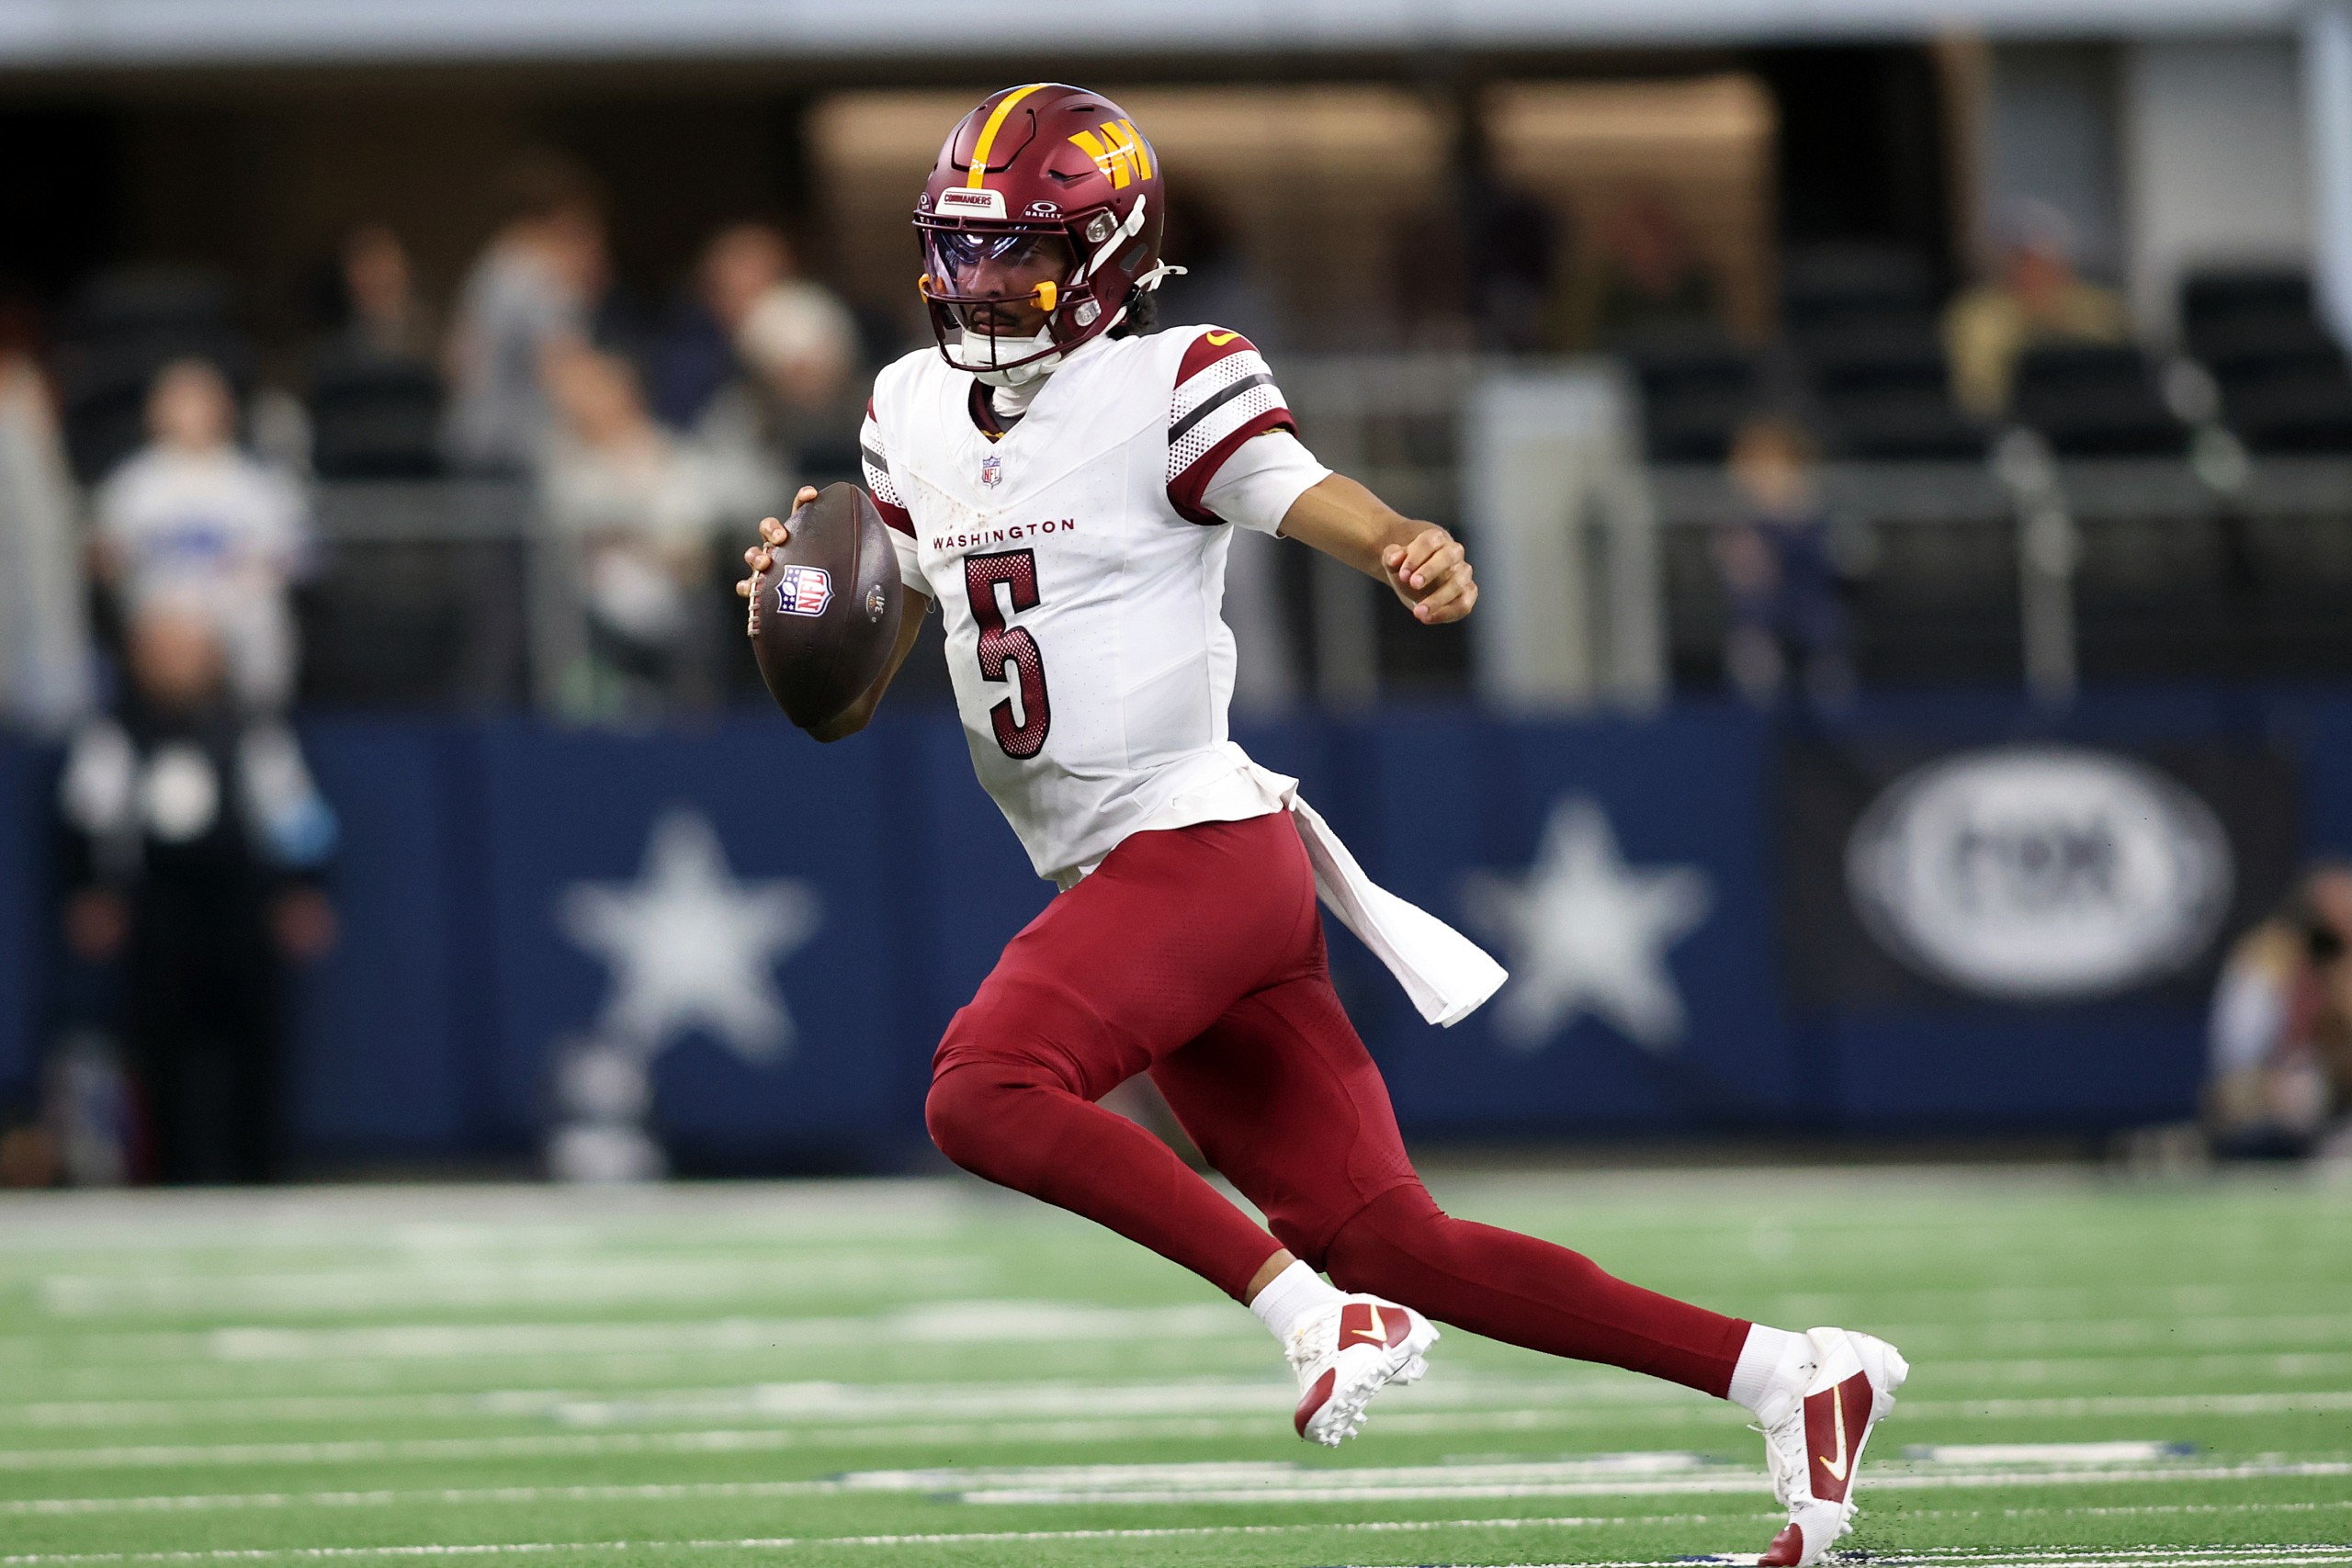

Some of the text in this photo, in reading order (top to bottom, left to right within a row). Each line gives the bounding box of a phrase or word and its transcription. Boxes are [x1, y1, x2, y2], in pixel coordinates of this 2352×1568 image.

[944, 193, 992, 206] COMMANDERS
[1024, 210, 1062, 220] OAKLEY
[982, 468, 999, 482] NFL
[933, 518, 1075, 549] WASHINGTON
[797, 574, 826, 611] NFL
[964, 547, 1051, 760] 5
